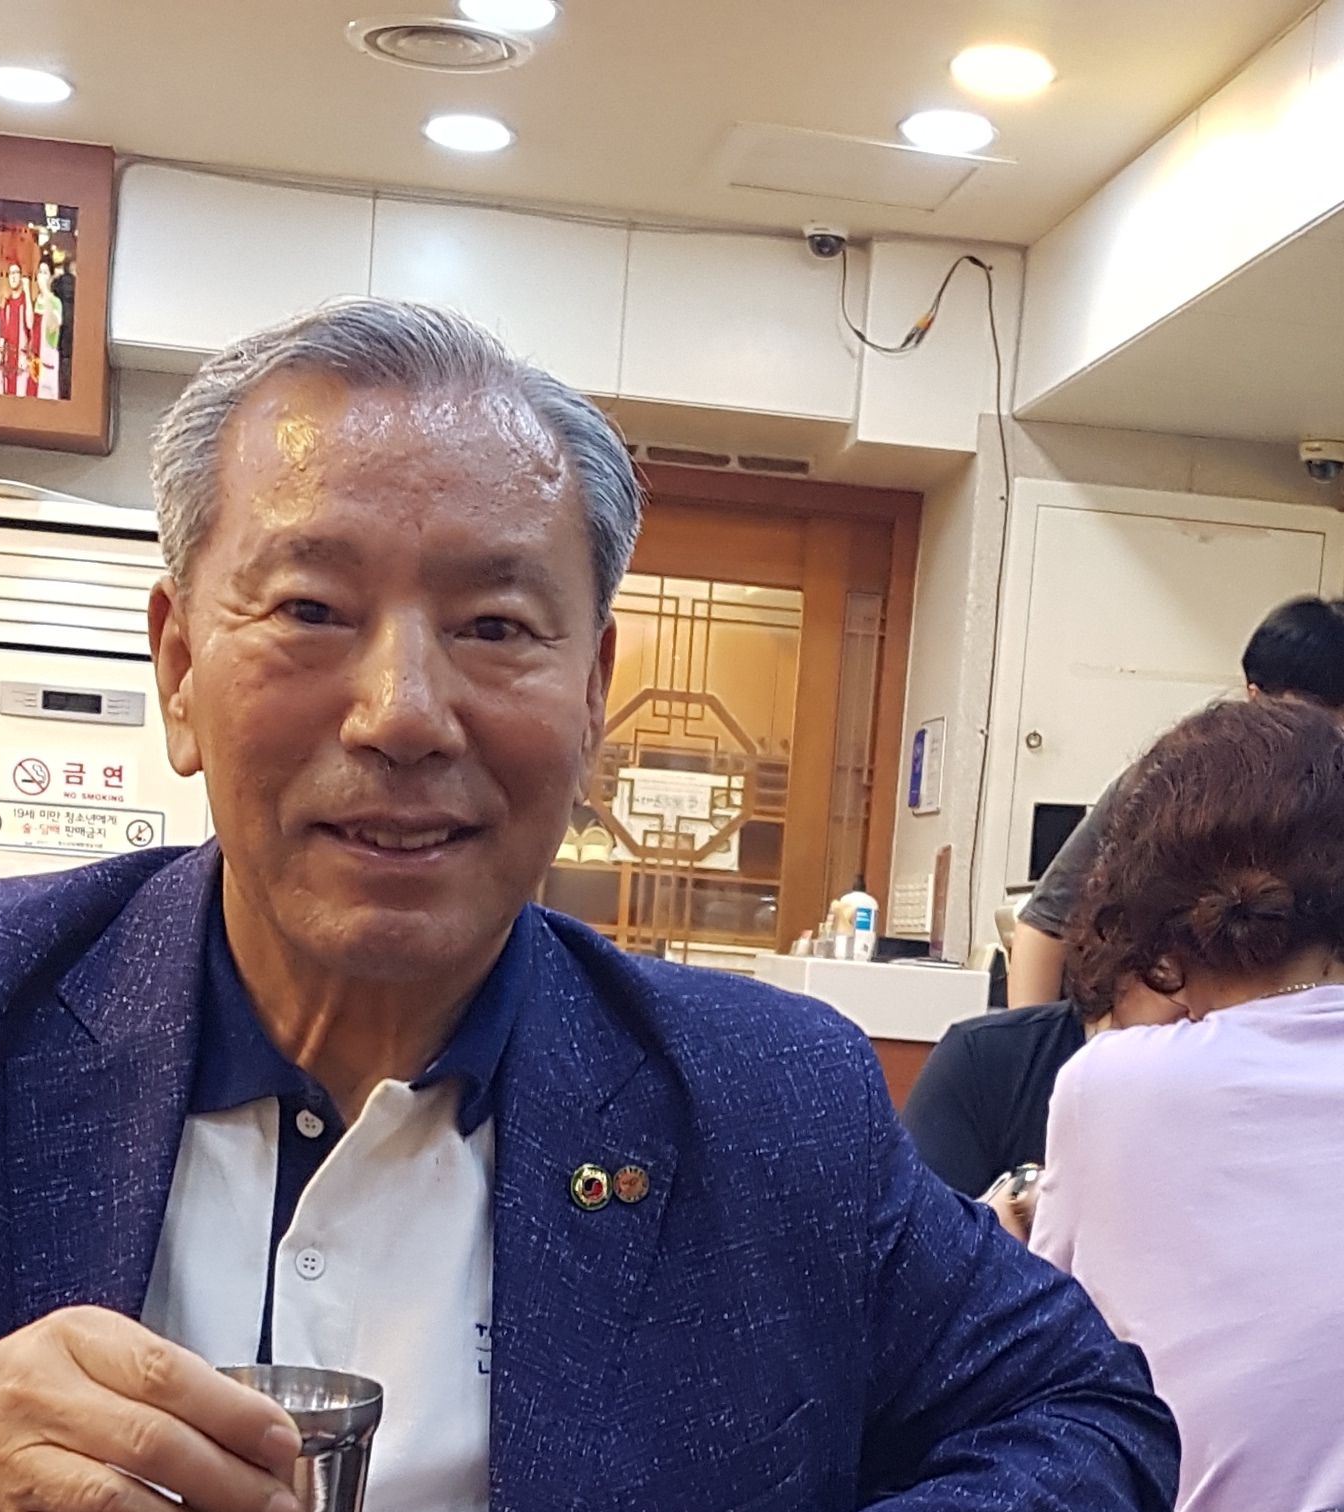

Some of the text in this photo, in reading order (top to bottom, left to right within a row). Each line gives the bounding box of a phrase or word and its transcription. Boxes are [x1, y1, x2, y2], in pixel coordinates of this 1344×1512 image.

[63, 791, 124, 802] NO SMOKING
[13, 808, 118, 825] 19세 미만 청소년에게
[64, 824, 107, 839] 판매금지
